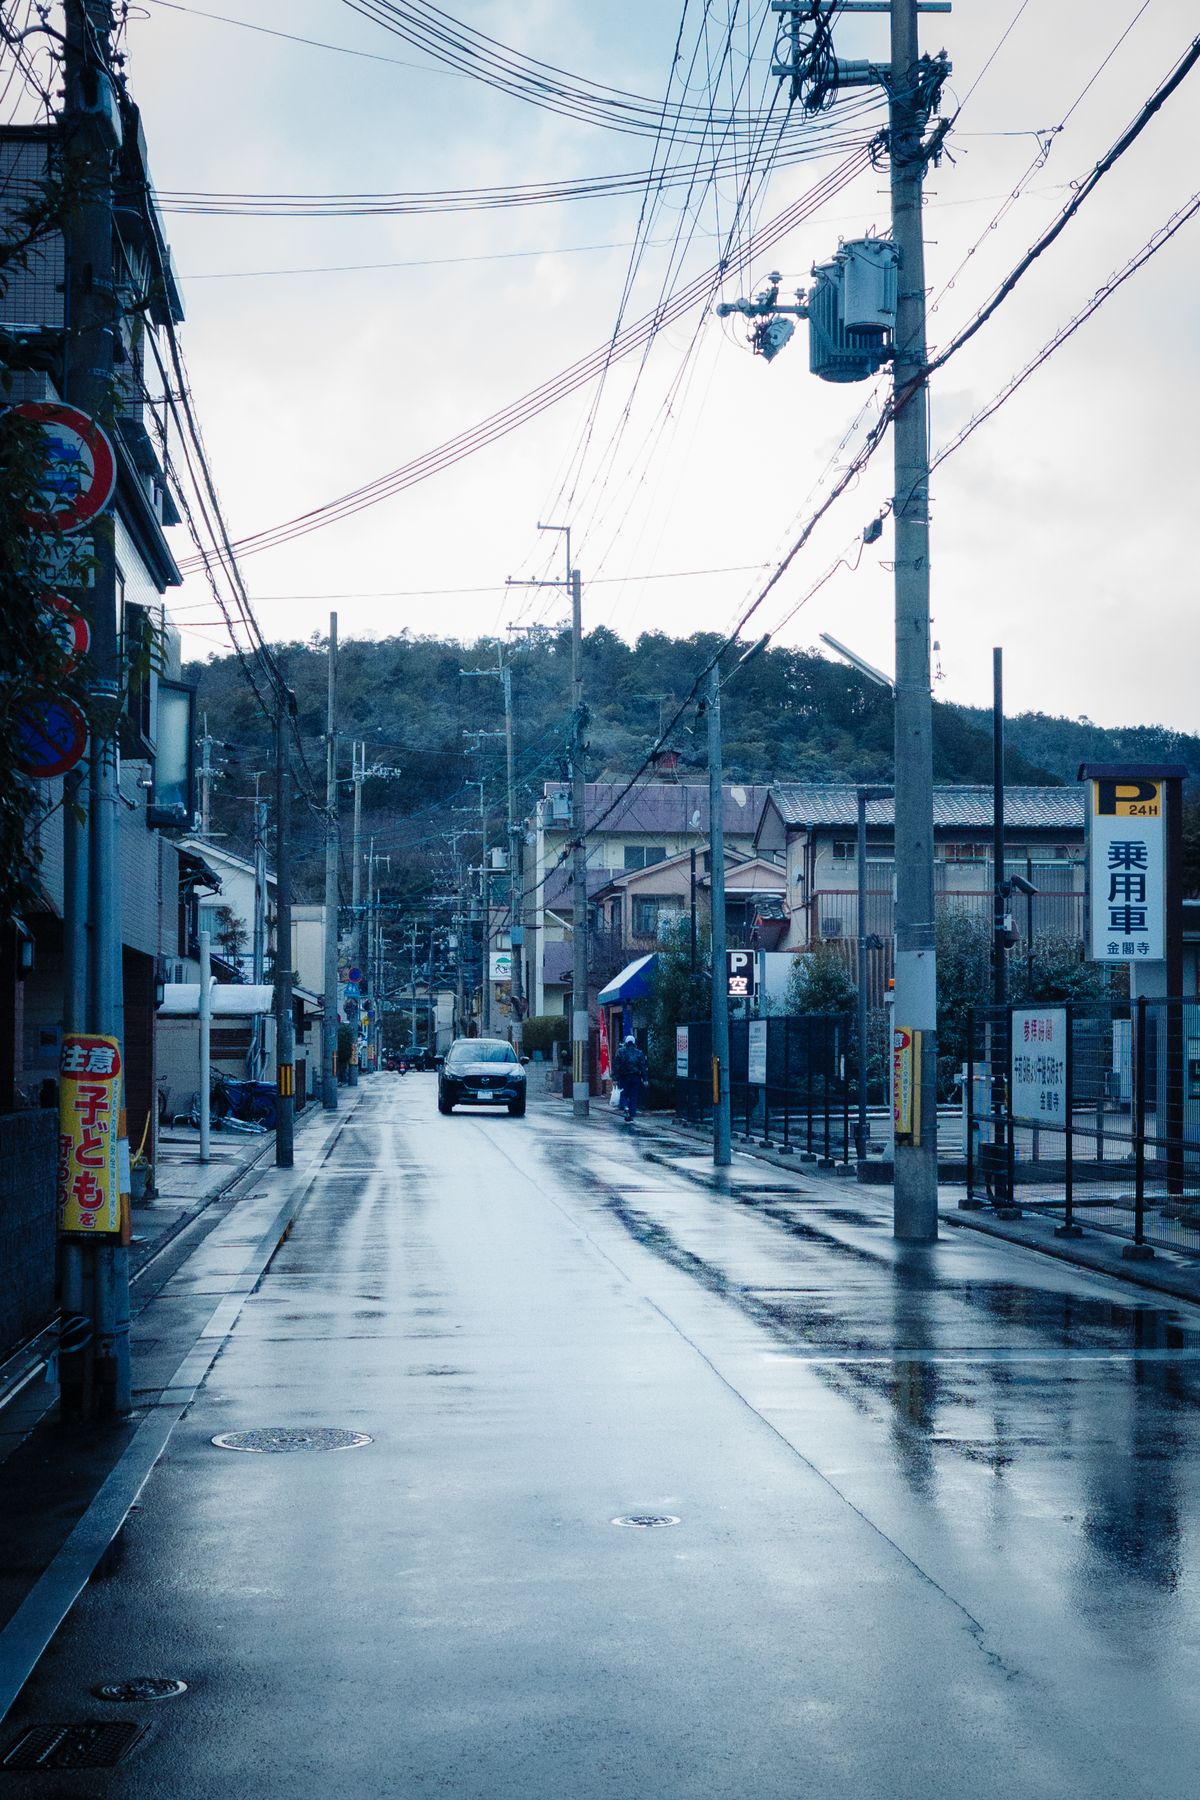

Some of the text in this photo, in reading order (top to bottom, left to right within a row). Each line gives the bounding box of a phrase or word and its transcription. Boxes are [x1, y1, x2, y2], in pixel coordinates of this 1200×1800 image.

[1098, 781, 1158, 815] P
[1129, 804, 1158, 816] 24H
[1107, 840, 1149, 936] 乗用車
[1106, 941, 1150, 956] 金閣寺
[730, 952, 748, 973] P
[729, 976, 748, 995] 空
[62, 1044, 115, 1074] 注意
[73, 1084, 110, 1228] 子どもを
